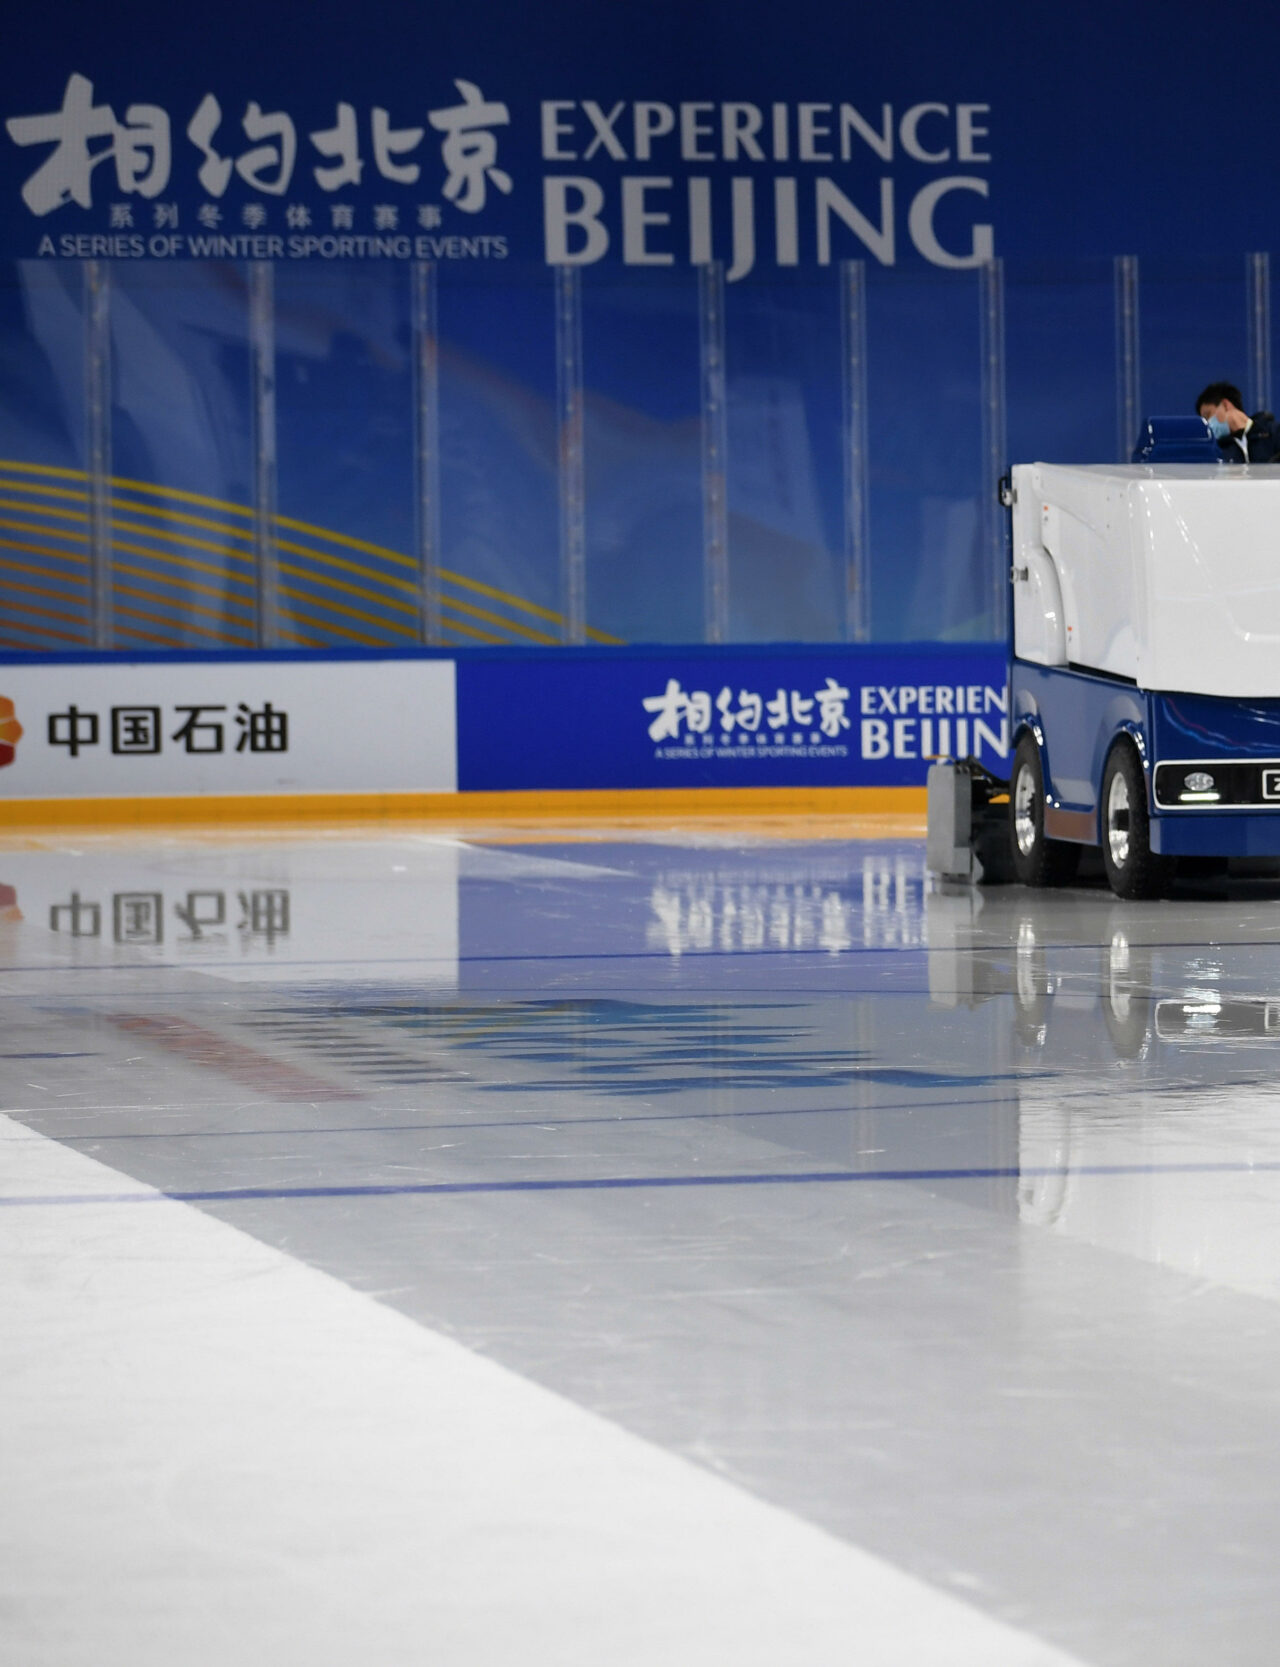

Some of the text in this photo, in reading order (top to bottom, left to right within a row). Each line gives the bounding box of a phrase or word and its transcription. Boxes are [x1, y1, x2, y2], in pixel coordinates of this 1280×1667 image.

[5, 72, 513, 216] 相约北京
[540, 101, 992, 163] EXPERIENCE
[38, 234, 508, 259] A SERIES OF WINTER SPORTING EVENTS
[543, 176, 995, 283] BEIJING
[47, 703, 289, 757] 中国石油
[642, 678, 851, 742] 相约北京
